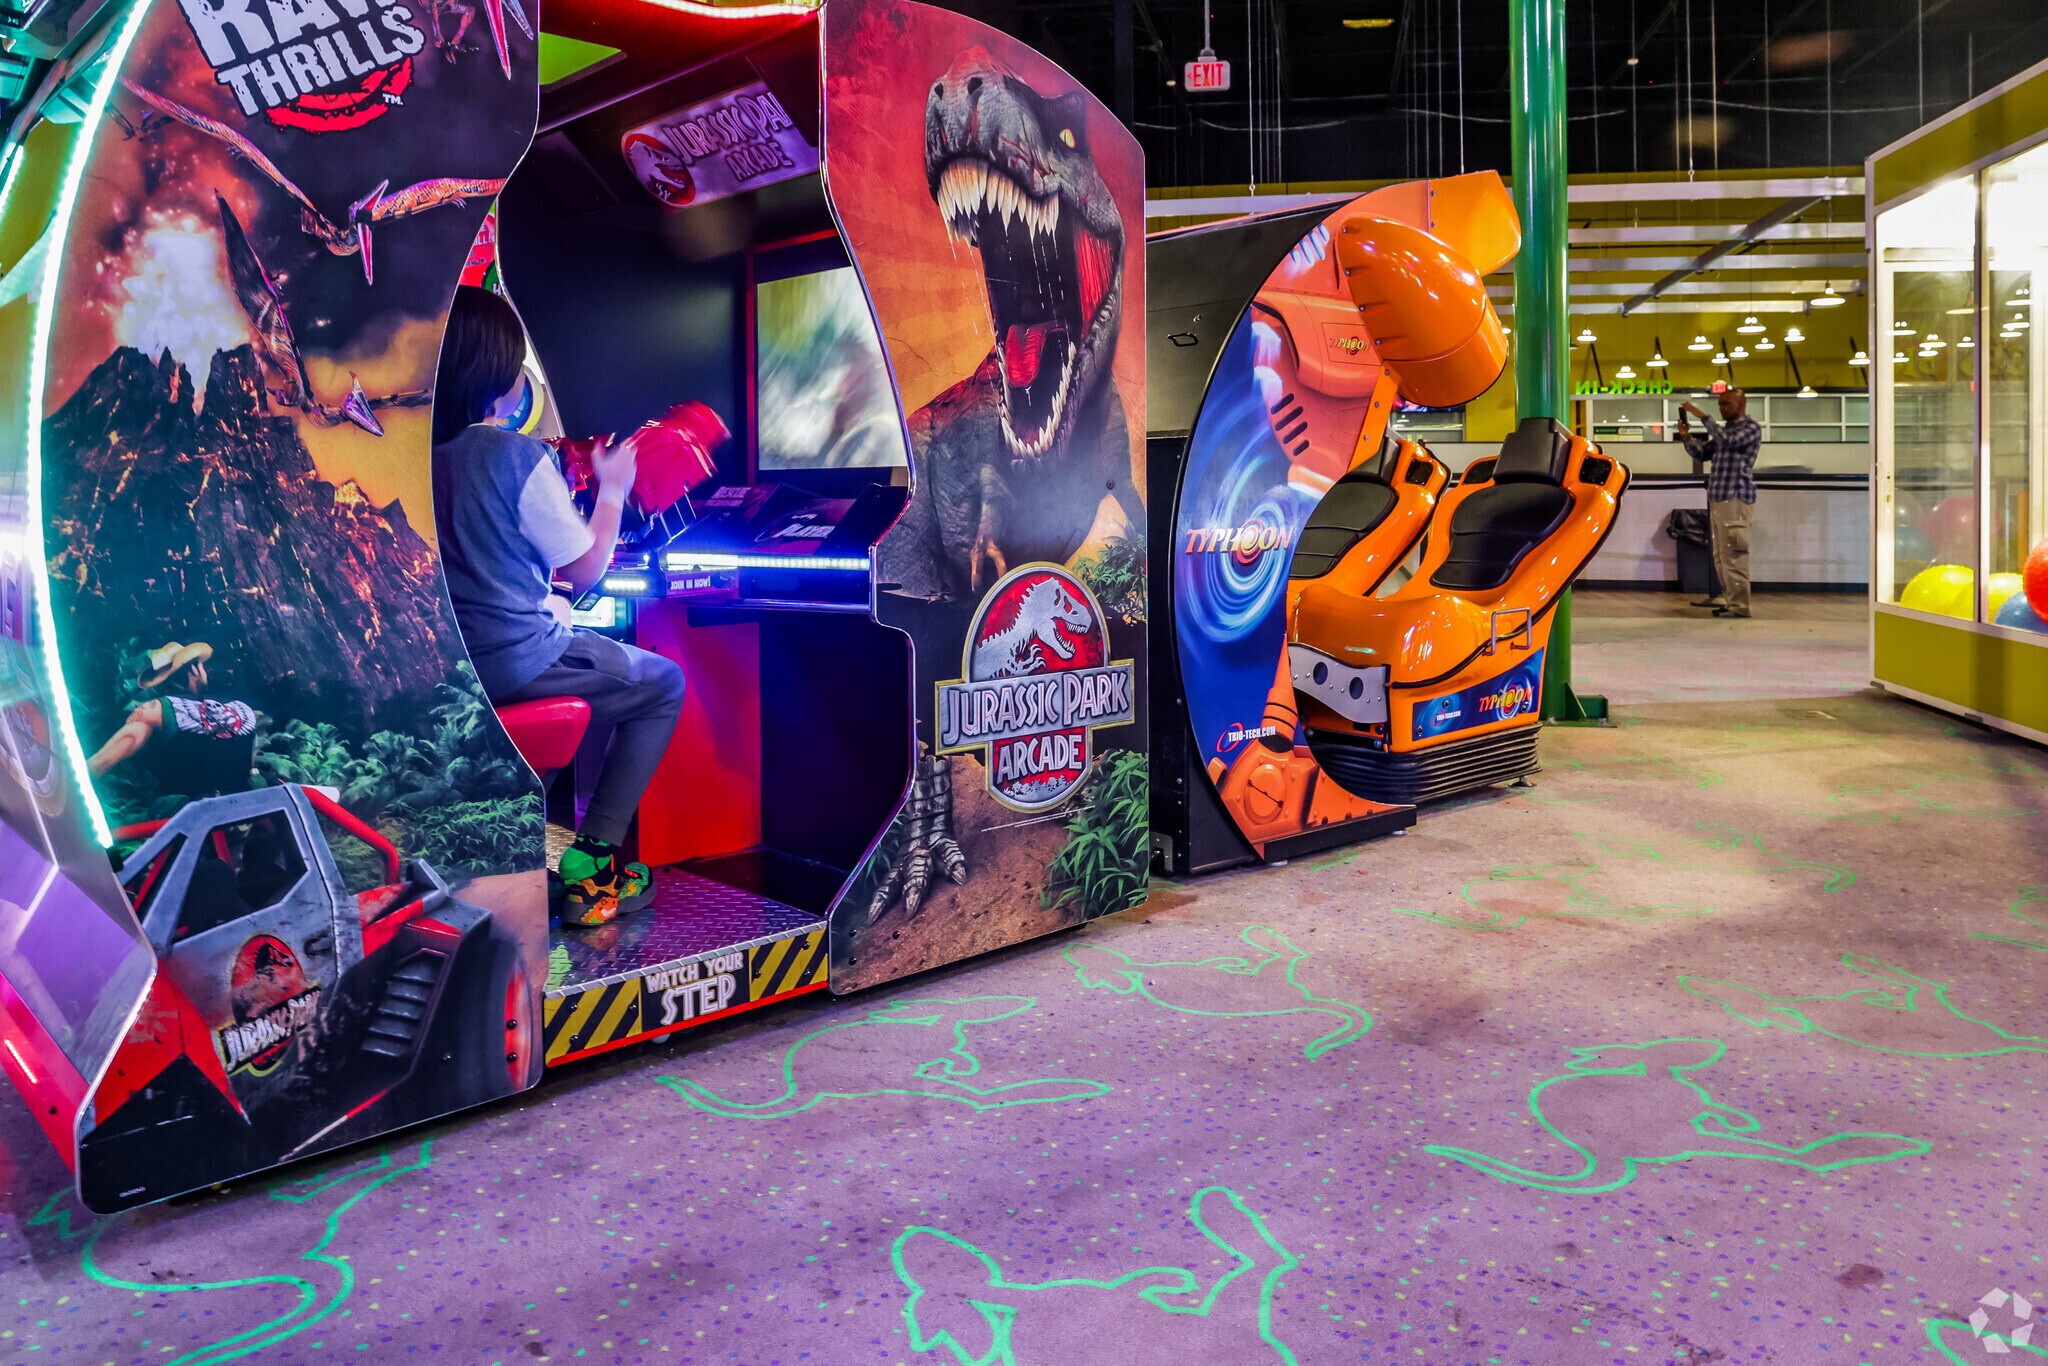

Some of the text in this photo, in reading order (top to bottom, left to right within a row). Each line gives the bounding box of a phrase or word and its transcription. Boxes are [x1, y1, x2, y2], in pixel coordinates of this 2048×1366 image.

[178, 0, 396, 66] RA
[217, 6, 424, 116] THRILLS
[1193, 63, 1224, 87] EXIT
[664, 106, 749, 164] JURASSIC
[726, 142, 793, 181] ARCADE
[1185, 526, 1294, 554] TYPHOON
[670, 580, 685, 590] JOIN
[943, 672, 1129, 744] JURASSIC PARK
[1478, 686, 1534, 713] TYPHOON
[1228, 726, 1276, 742] TRIO-TECH.COM
[996, 734, 1082, 784] ARCADE
[645, 952, 744, 993] WATCH YOUR
[661, 973, 737, 1026] STEP
